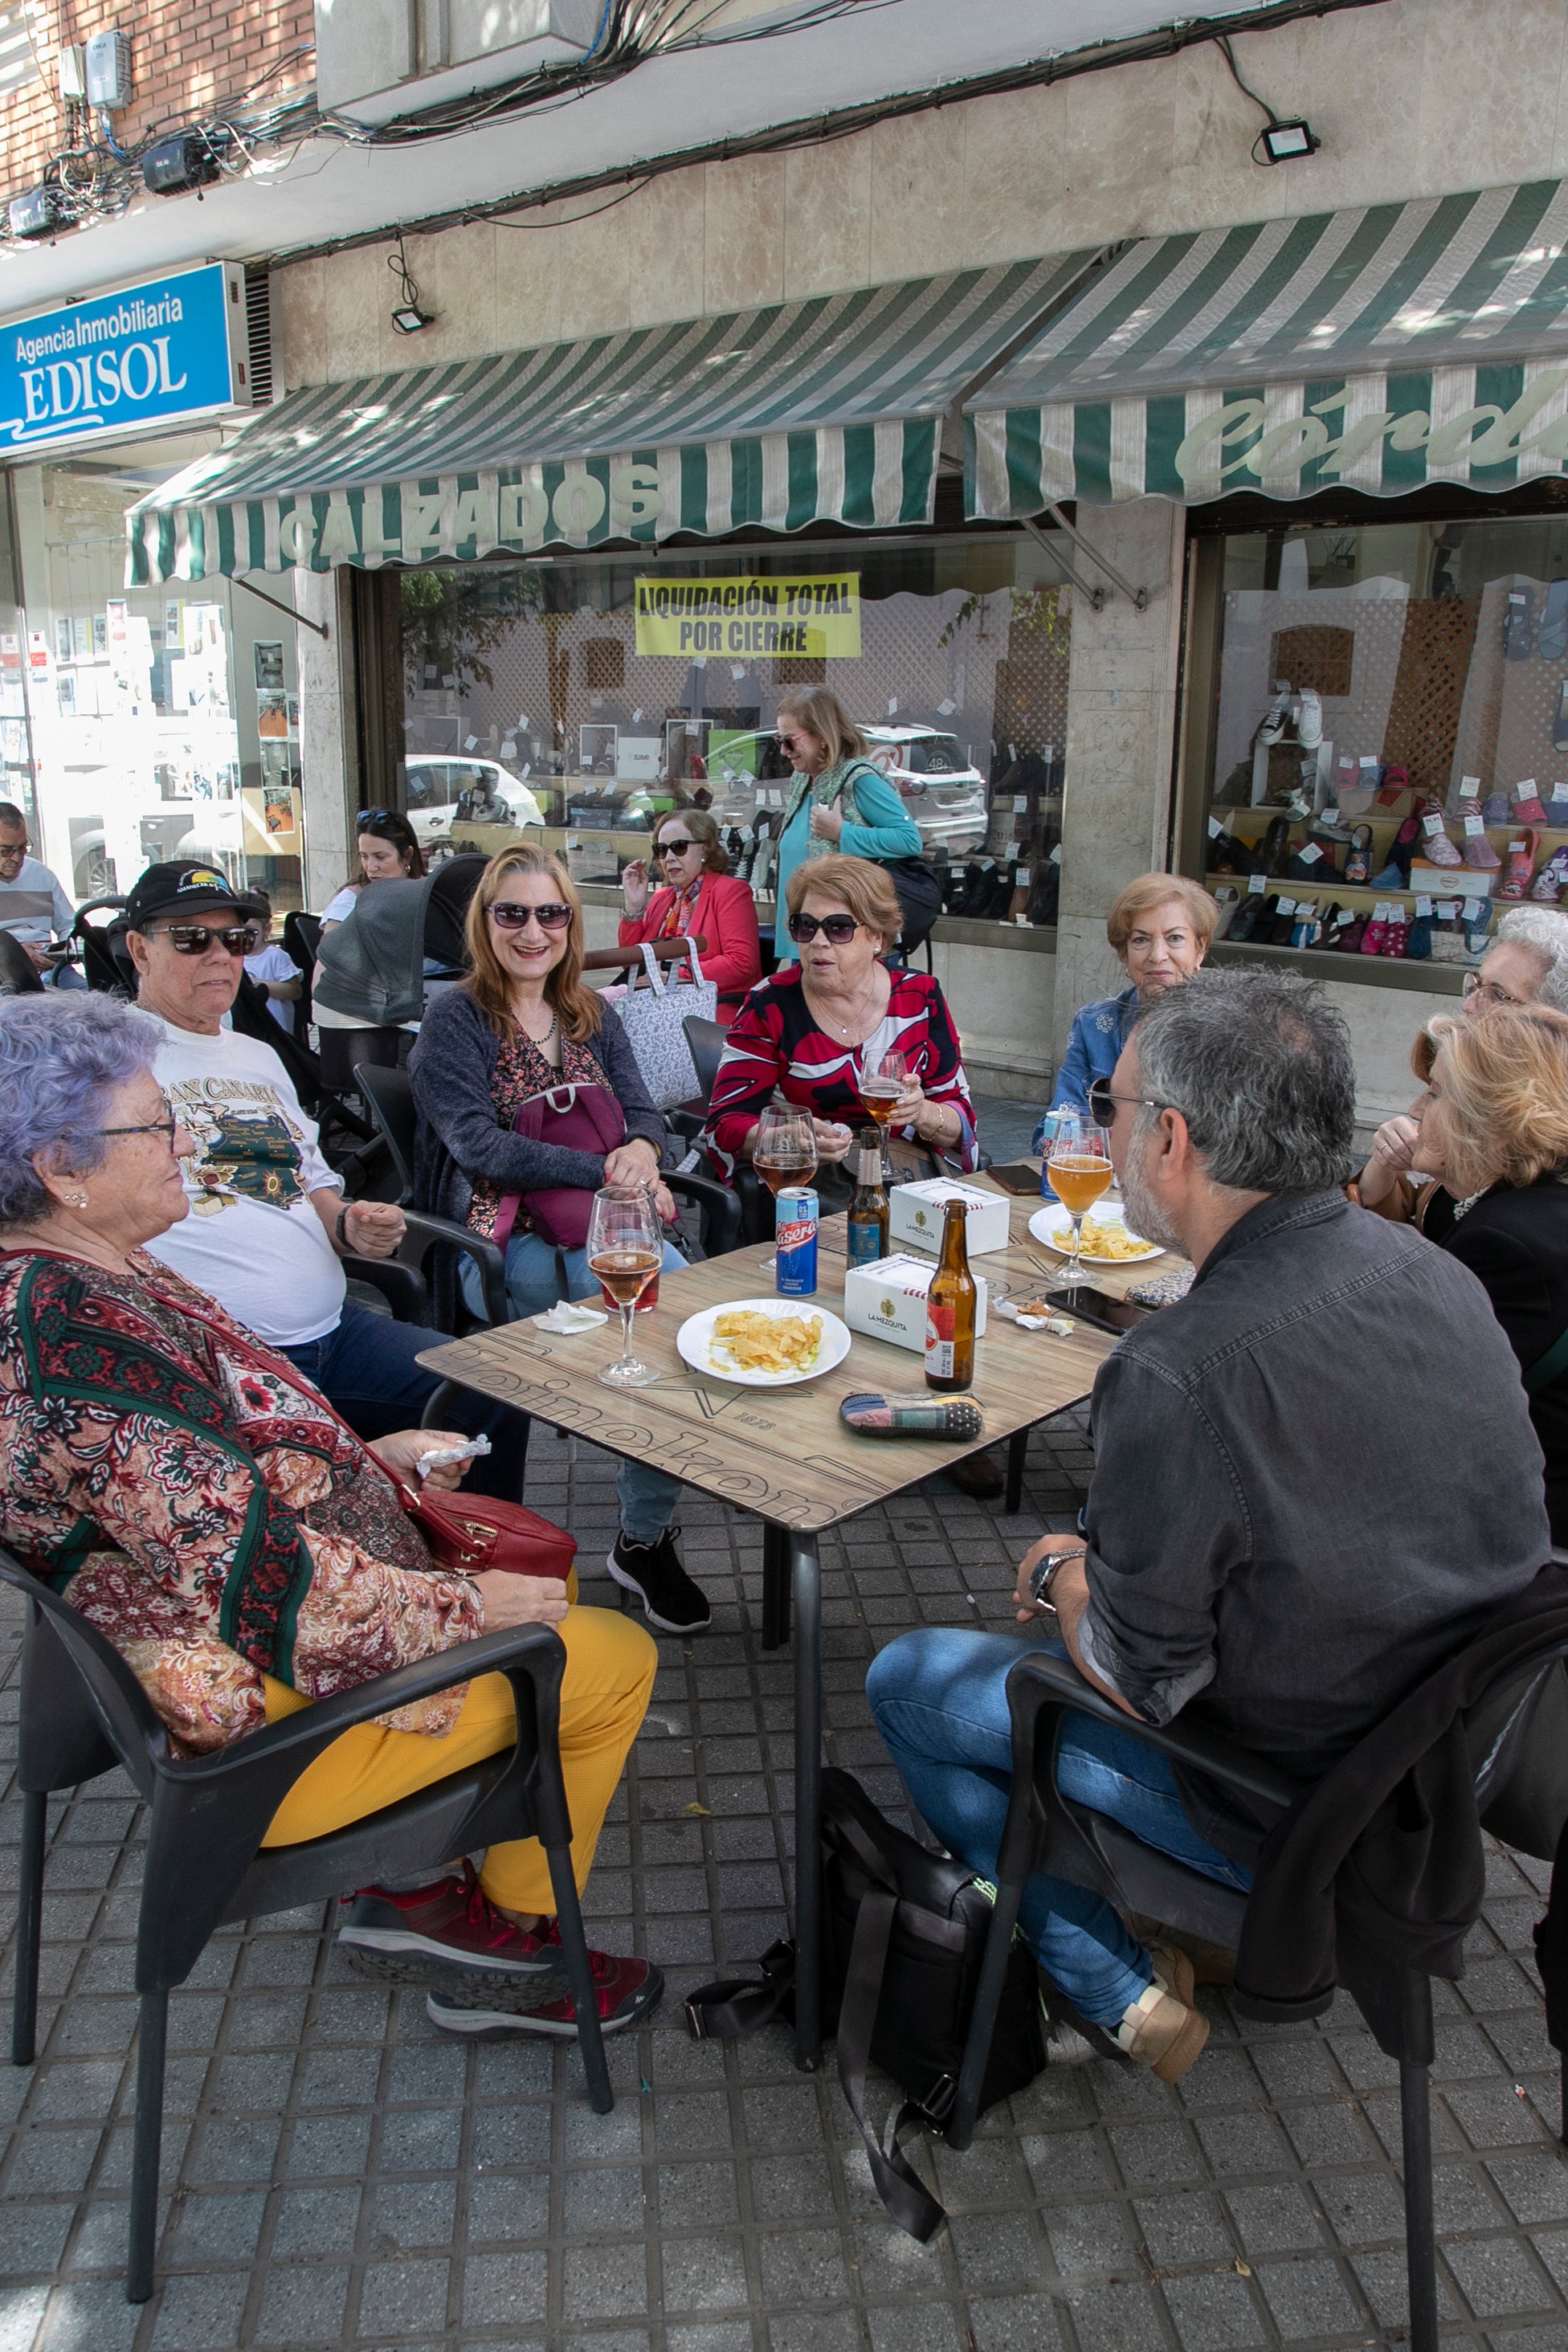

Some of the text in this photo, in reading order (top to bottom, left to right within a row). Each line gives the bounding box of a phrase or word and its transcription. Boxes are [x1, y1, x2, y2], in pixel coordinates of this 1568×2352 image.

[19, 336, 187, 423] EDISOL
[280, 463, 665, 561] CALZADOS
[639, 579, 852, 619] LIQUIDACIÓN TOTAL
[680, 621, 808, 651] POR CIERRE
[776, 1219, 816, 1245] asera
[868, 1313, 907, 1331] LA MEZQUITA
[733, 1412, 777, 1431] 1873
